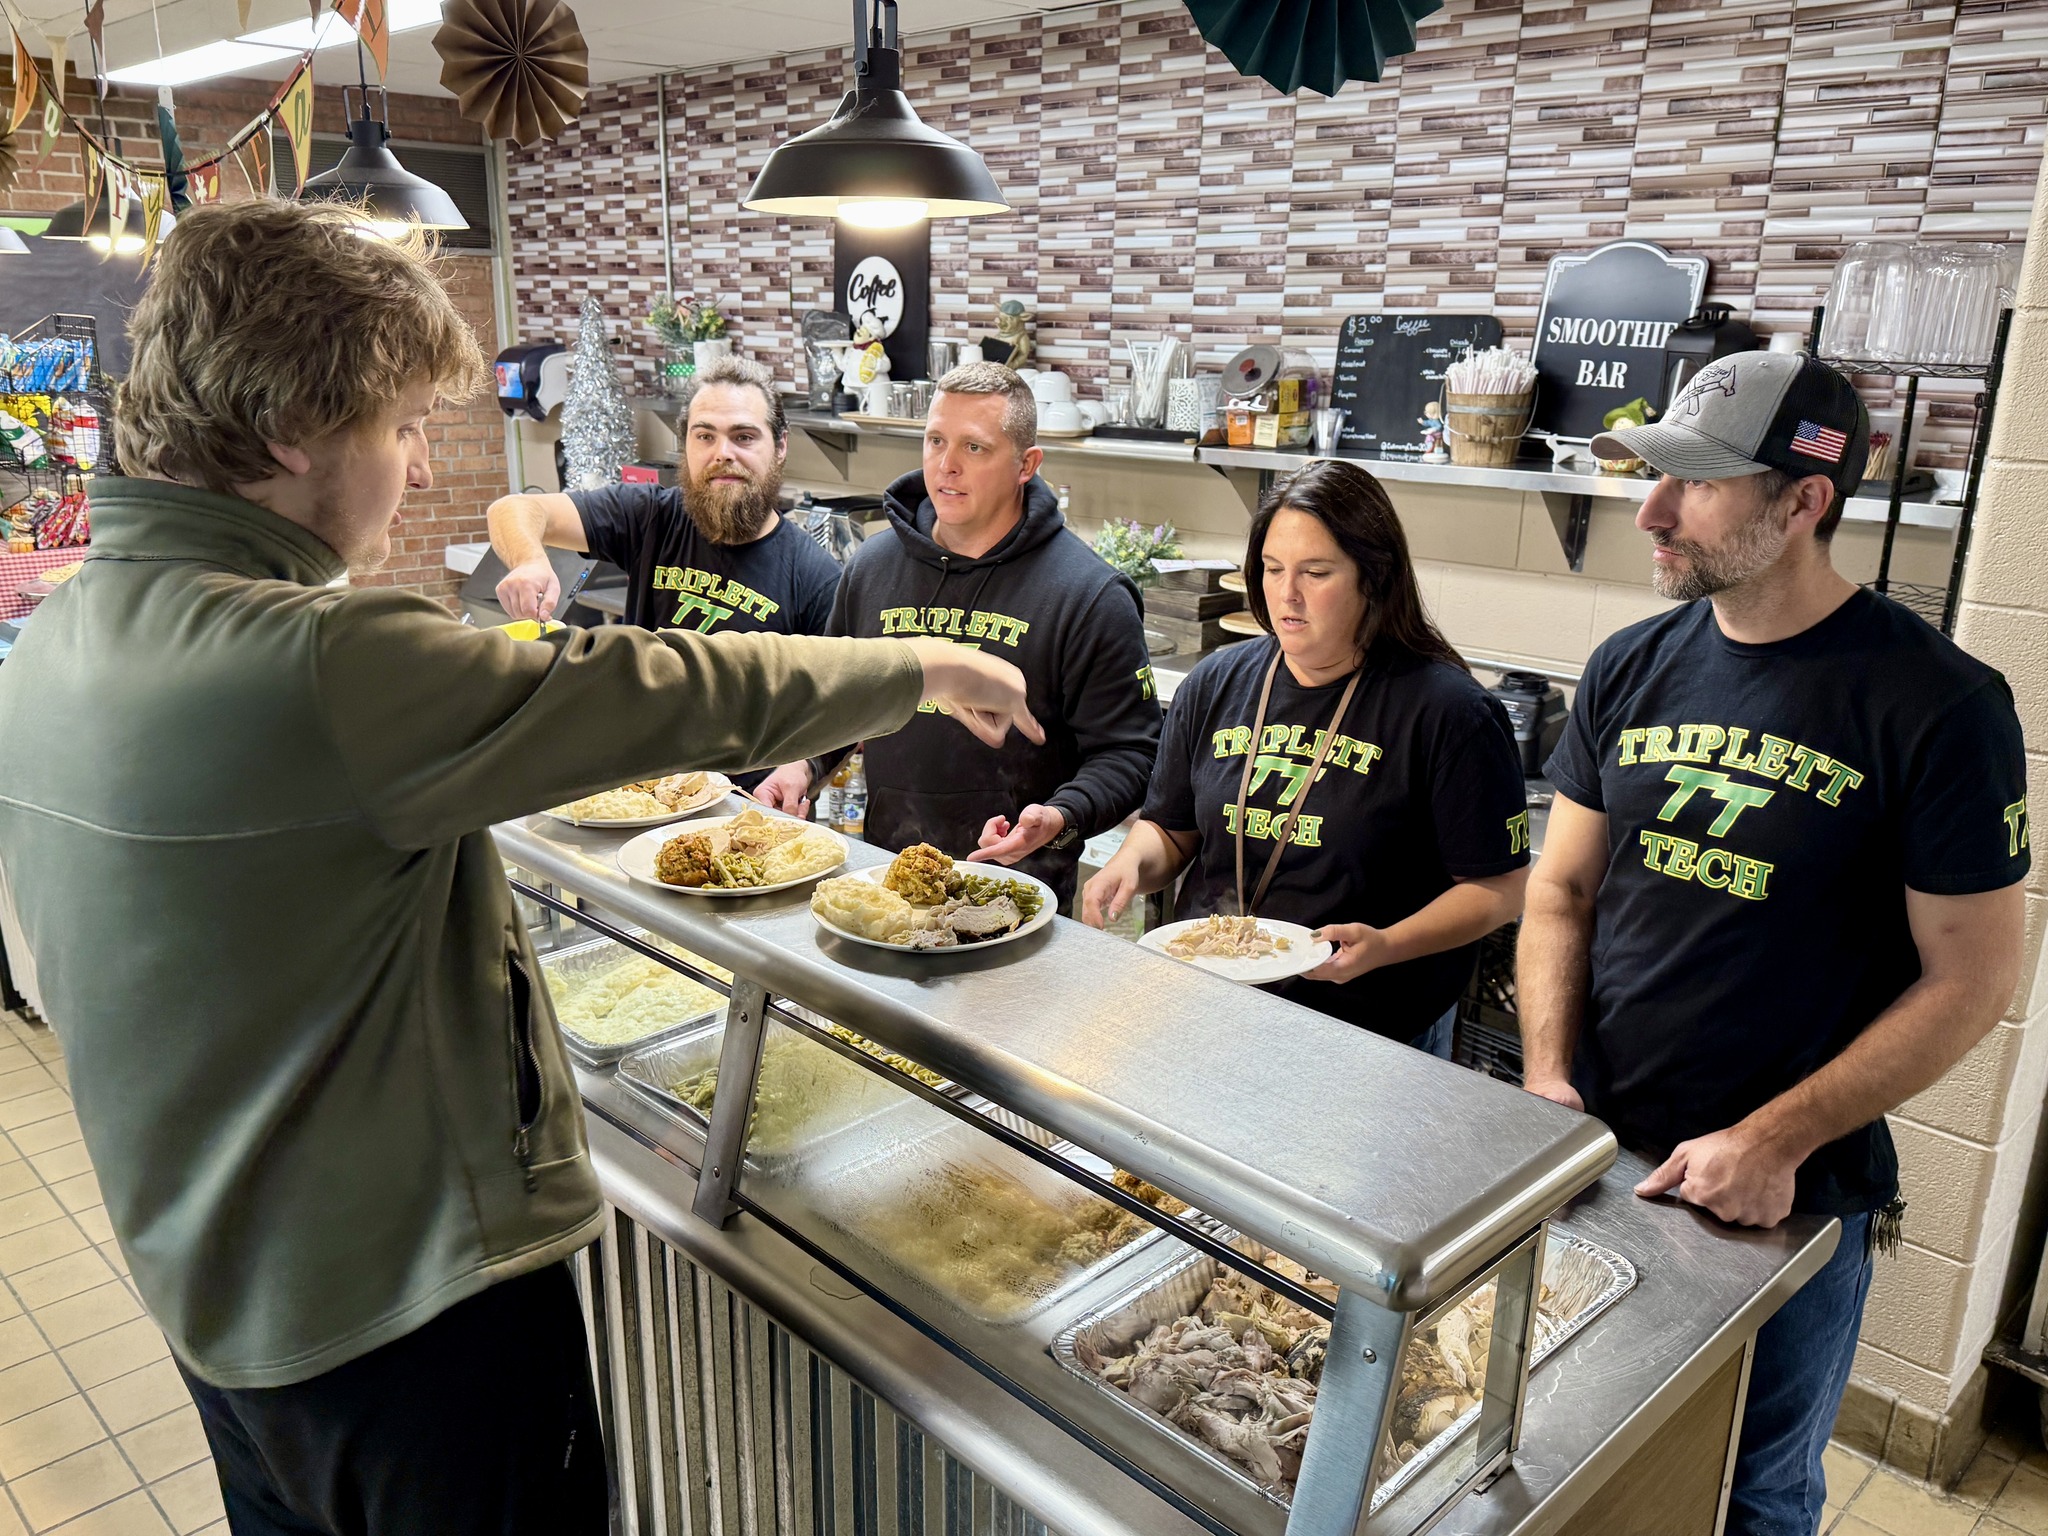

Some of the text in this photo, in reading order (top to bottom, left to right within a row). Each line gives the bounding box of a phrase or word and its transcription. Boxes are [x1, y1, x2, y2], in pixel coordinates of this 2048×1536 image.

[849, 273, 896, 308] Coffee
[1396, 315, 1430, 336] Coffee
[1575, 359, 1628, 389] BAR
[652, 565, 780, 622] TRIPLETT
[880, 606, 1029, 647] TRIPLETT
[1618, 723, 1865, 808] TRIPLETT
[1656, 764, 1776, 838] TT
[1223, 803, 1323, 847] TECH
[1640, 829, 1774, 901] TECH
